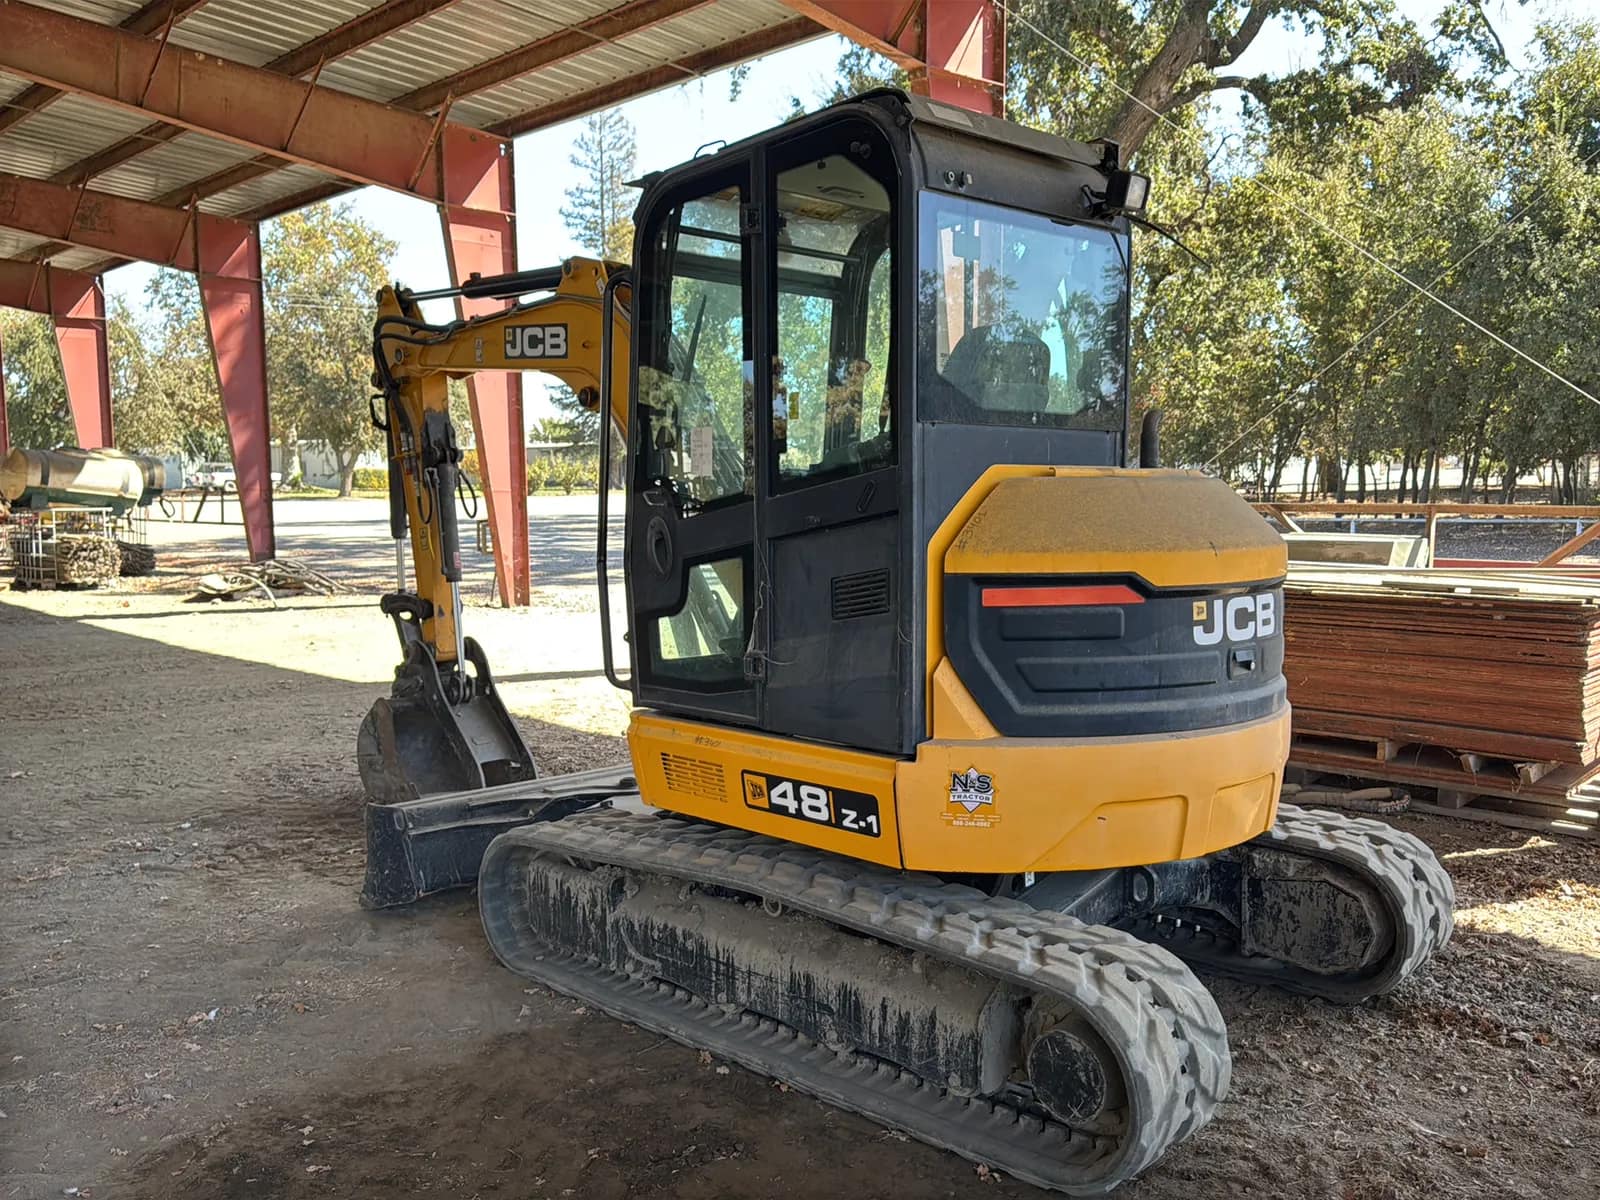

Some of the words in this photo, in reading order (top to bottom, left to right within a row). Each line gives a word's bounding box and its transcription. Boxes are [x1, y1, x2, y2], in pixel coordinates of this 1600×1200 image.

[506, 326, 567, 357] JCB
[1193, 593, 1275, 646] JCB
[770, 781, 830, 822] 48
[951, 794, 991, 802] TRACTOR
